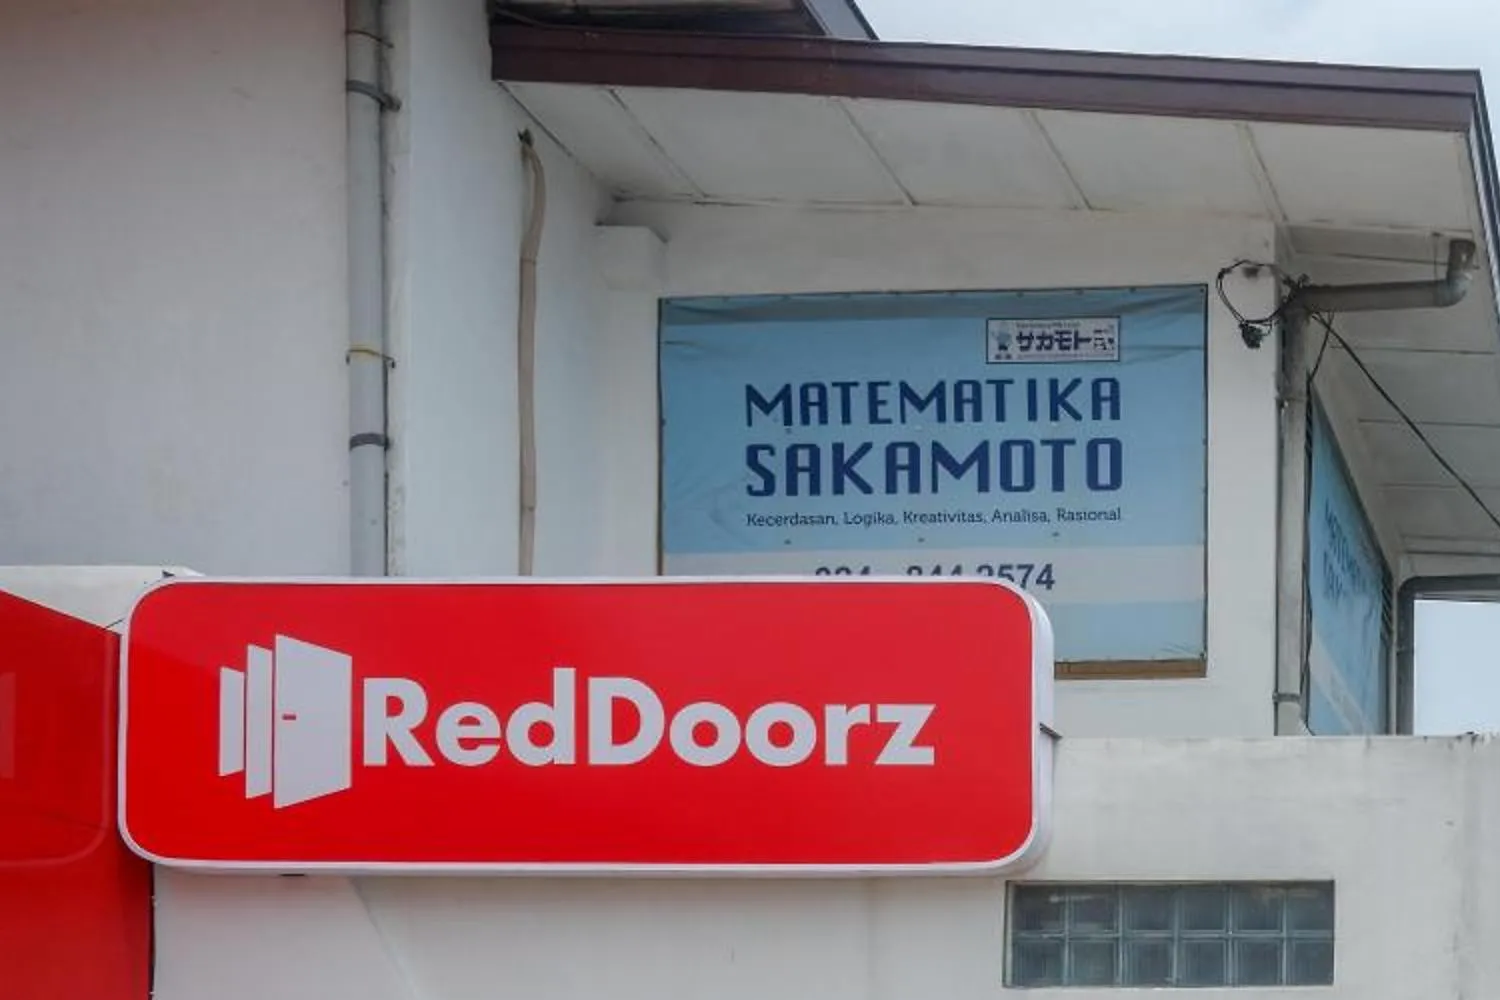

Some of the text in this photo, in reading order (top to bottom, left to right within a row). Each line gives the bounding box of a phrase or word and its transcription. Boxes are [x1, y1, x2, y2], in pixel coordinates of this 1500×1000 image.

[745, 377, 1122, 427] MATEMATIKA
[746, 437, 1123, 497] SAKAMOTO
[747, 507, 1121, 528] Kecerdasan, Logika, Kreativitas, Analisa, Rasional
[363, 667, 937, 767] RedDoorz
